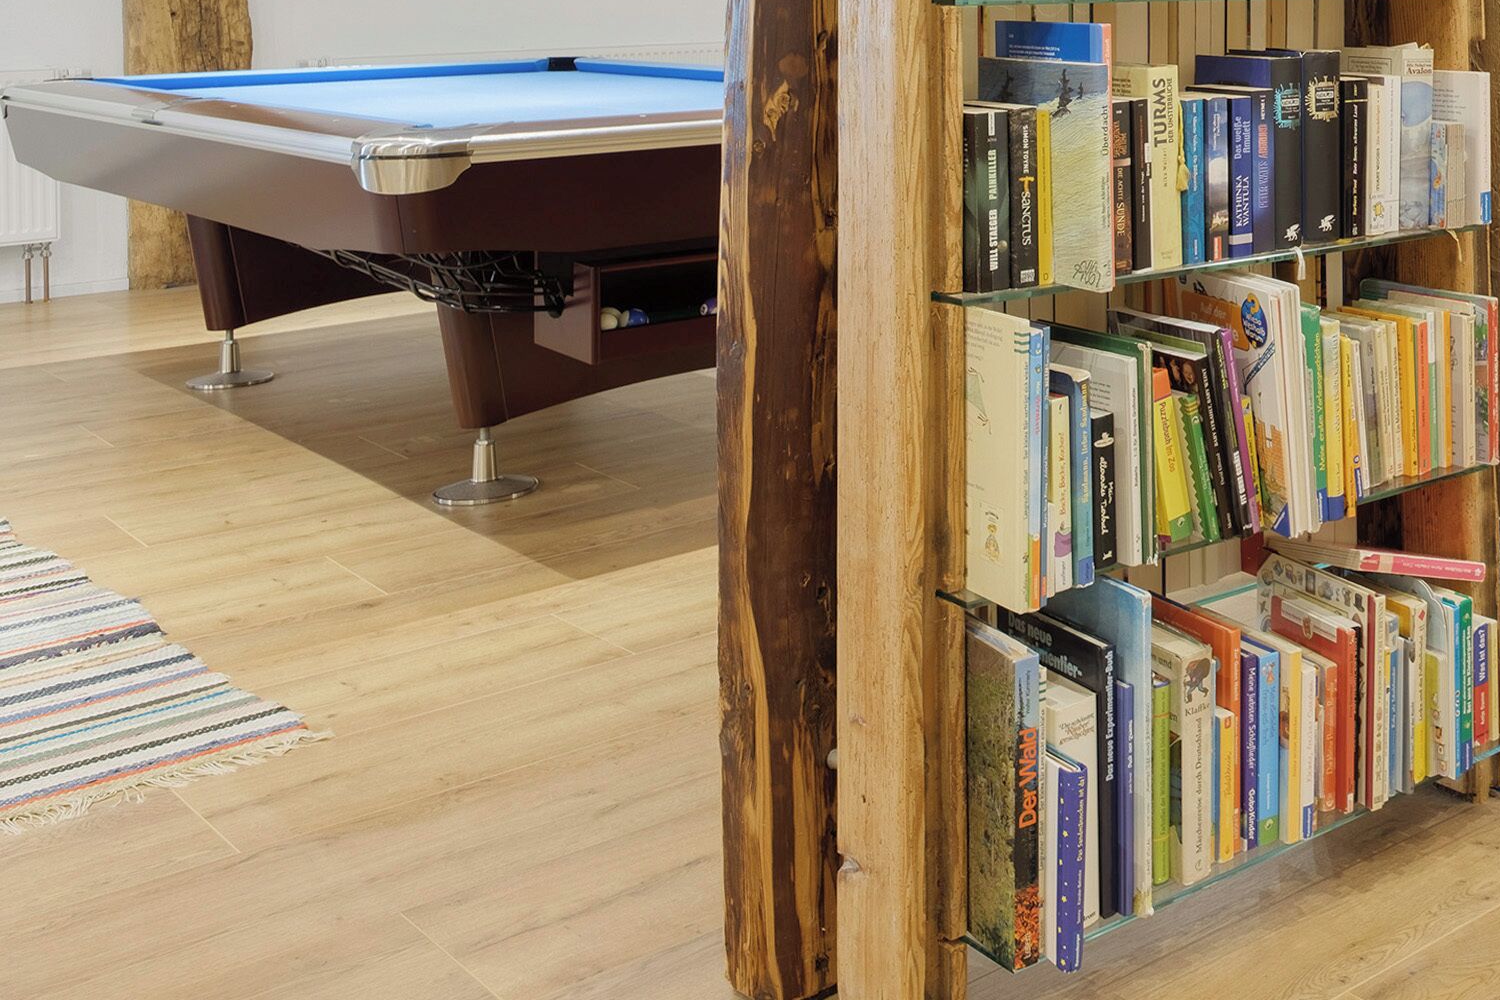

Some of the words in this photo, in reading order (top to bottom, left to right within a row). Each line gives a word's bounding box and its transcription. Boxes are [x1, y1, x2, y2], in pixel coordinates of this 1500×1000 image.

[1152, 78, 1168, 148] TURMS
[1100, 104, 1109, 157] Überdacht
[1233, 116, 1242, 142] weiße
[1243, 120, 1251, 154] Amulett
[1233, 143, 1242, 160] Das
[988, 149, 997, 200] PAINKILLER
[1242, 175, 1250, 227] WANTULA
[989, 209, 998, 247] STAEGER
[990, 248, 998, 271] WILL
[1080, 384, 1088, 428] Sandmann
[1205, 387, 1213, 403] BABY
[1211, 432, 1219, 447] BABY
[1167, 456, 1176, 473] Zoo
[1316, 446, 1325, 471] Meine
[1081, 457, 1089, 504] Sandmann,
[1058, 490, 1067, 516] Backe,
[1240, 494, 1248, 505] FIT
[1007, 611, 1026, 632] Das
[1027, 623, 1053, 646] neue
[1478, 629, 1487, 650] das?
[1478, 652, 1487, 664] ist
[1248, 667, 1256, 692] Meine
[1478, 665, 1487, 681] Was
[1105, 650, 1115, 739] Experimentier-Buch
[1105, 741, 1114, 763] neue
[1194, 717, 1203, 770] Deutschland
[1247, 724, 1257, 769] Schlaflieder
[1018, 727, 1037, 788] Wald
[1104, 764, 1114, 782] Das
[1195, 771, 1203, 795] durch
[1018, 788, 1037, 829] Der
[1076, 799, 1085, 848] Sandmännchen
[1194, 798, 1203, 854] Märchenreise
[1076, 848, 1084, 863] Das
